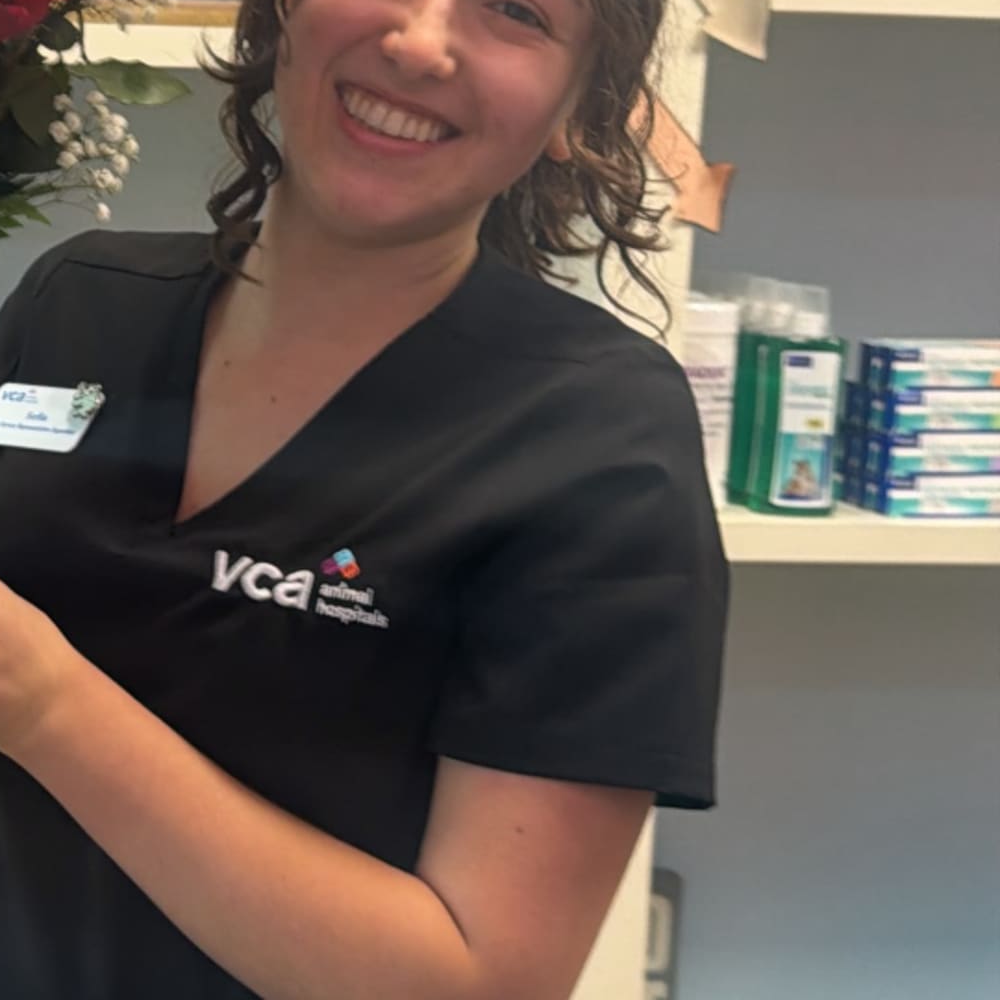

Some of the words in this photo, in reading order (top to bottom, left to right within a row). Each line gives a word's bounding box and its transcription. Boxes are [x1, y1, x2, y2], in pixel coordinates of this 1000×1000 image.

[211, 549, 315, 611] vca
[319, 581, 375, 606] animal
[315, 598, 390, 629] hospitals
